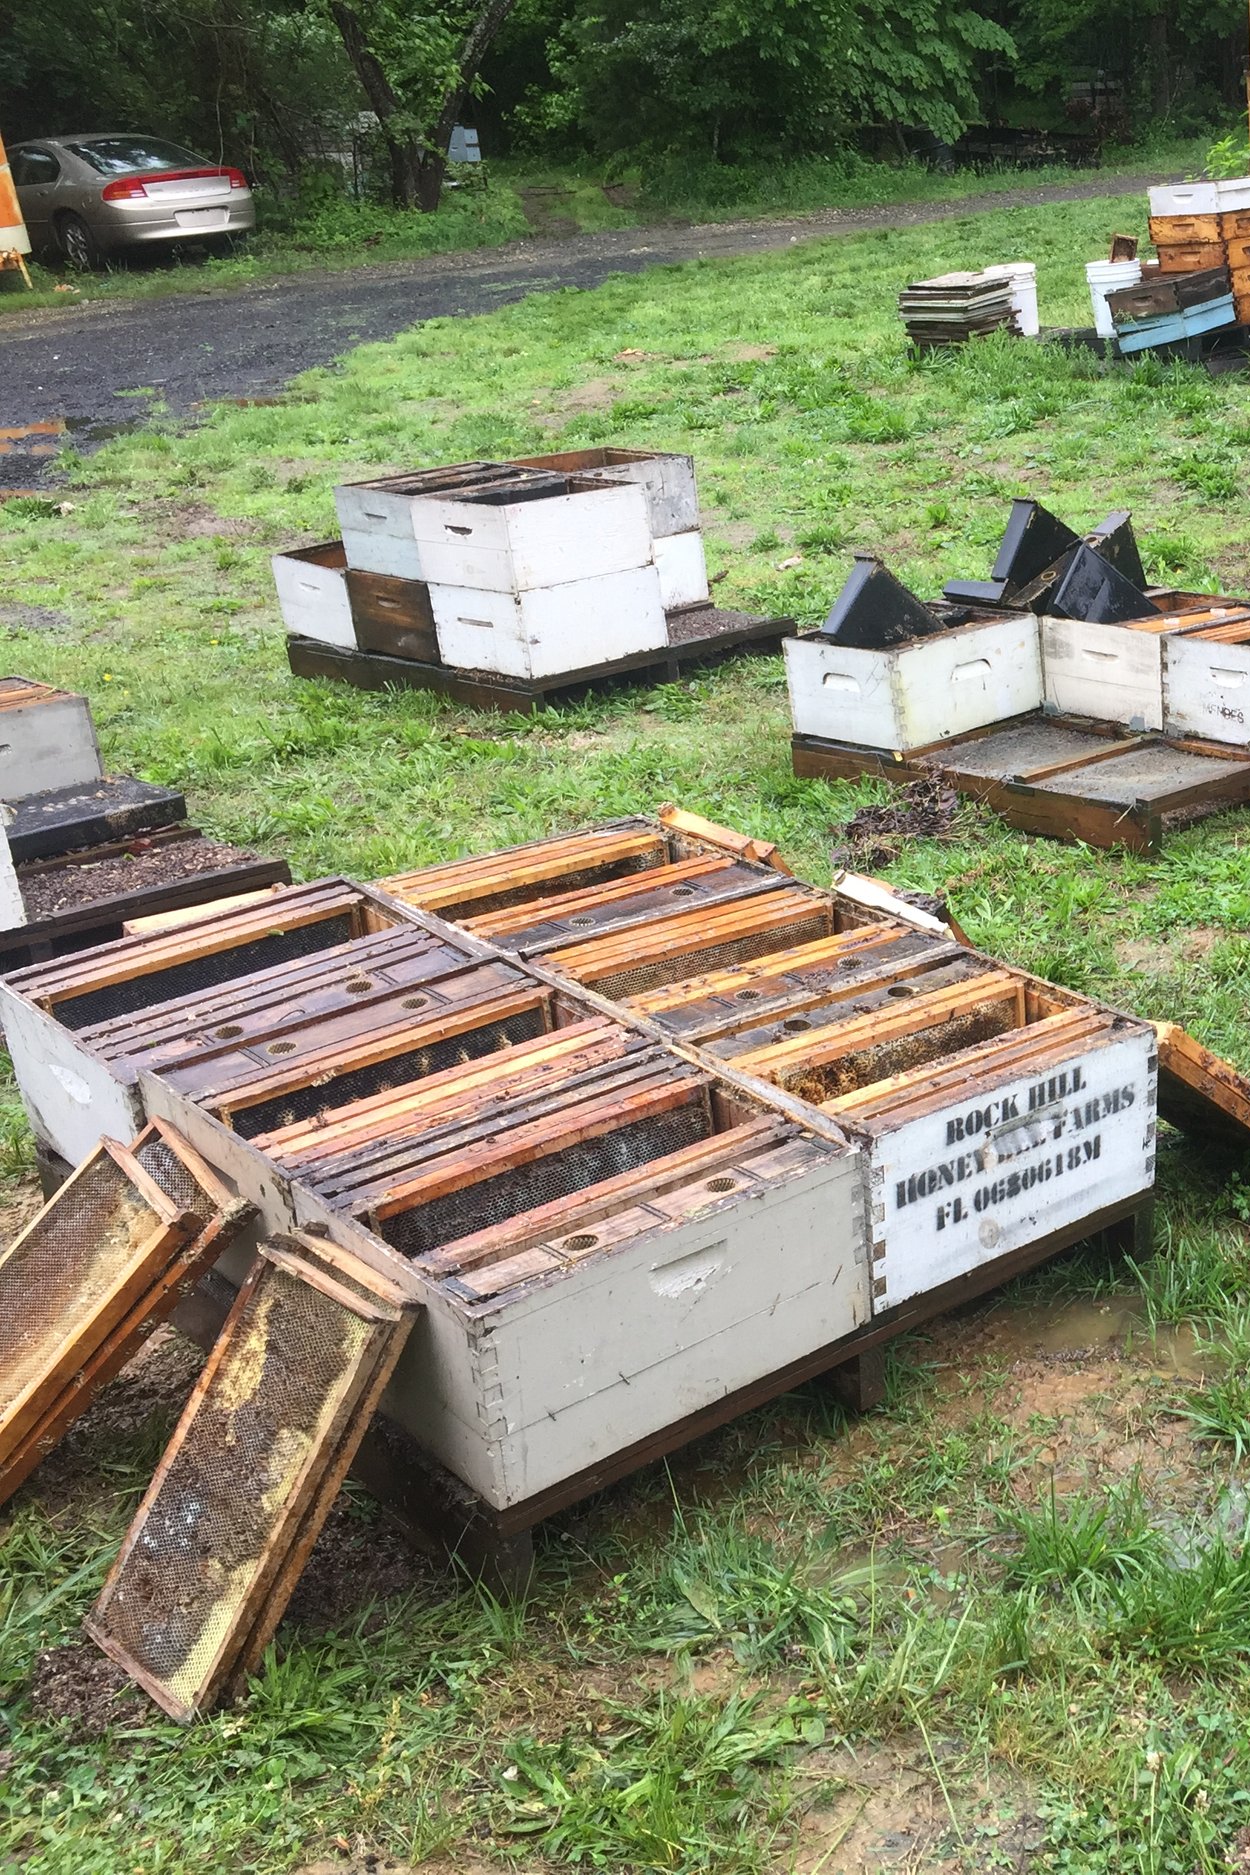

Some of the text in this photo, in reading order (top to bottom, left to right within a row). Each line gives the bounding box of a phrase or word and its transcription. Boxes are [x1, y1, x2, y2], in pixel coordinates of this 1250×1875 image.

[895, 1147, 985, 1209] HONEY
[1053, 1082, 1136, 1140] FARMS
[945, 1093, 1019, 1146] ROCK
[1028, 1066, 1087, 1111] HILL
[936, 1197, 969, 1231] FL
